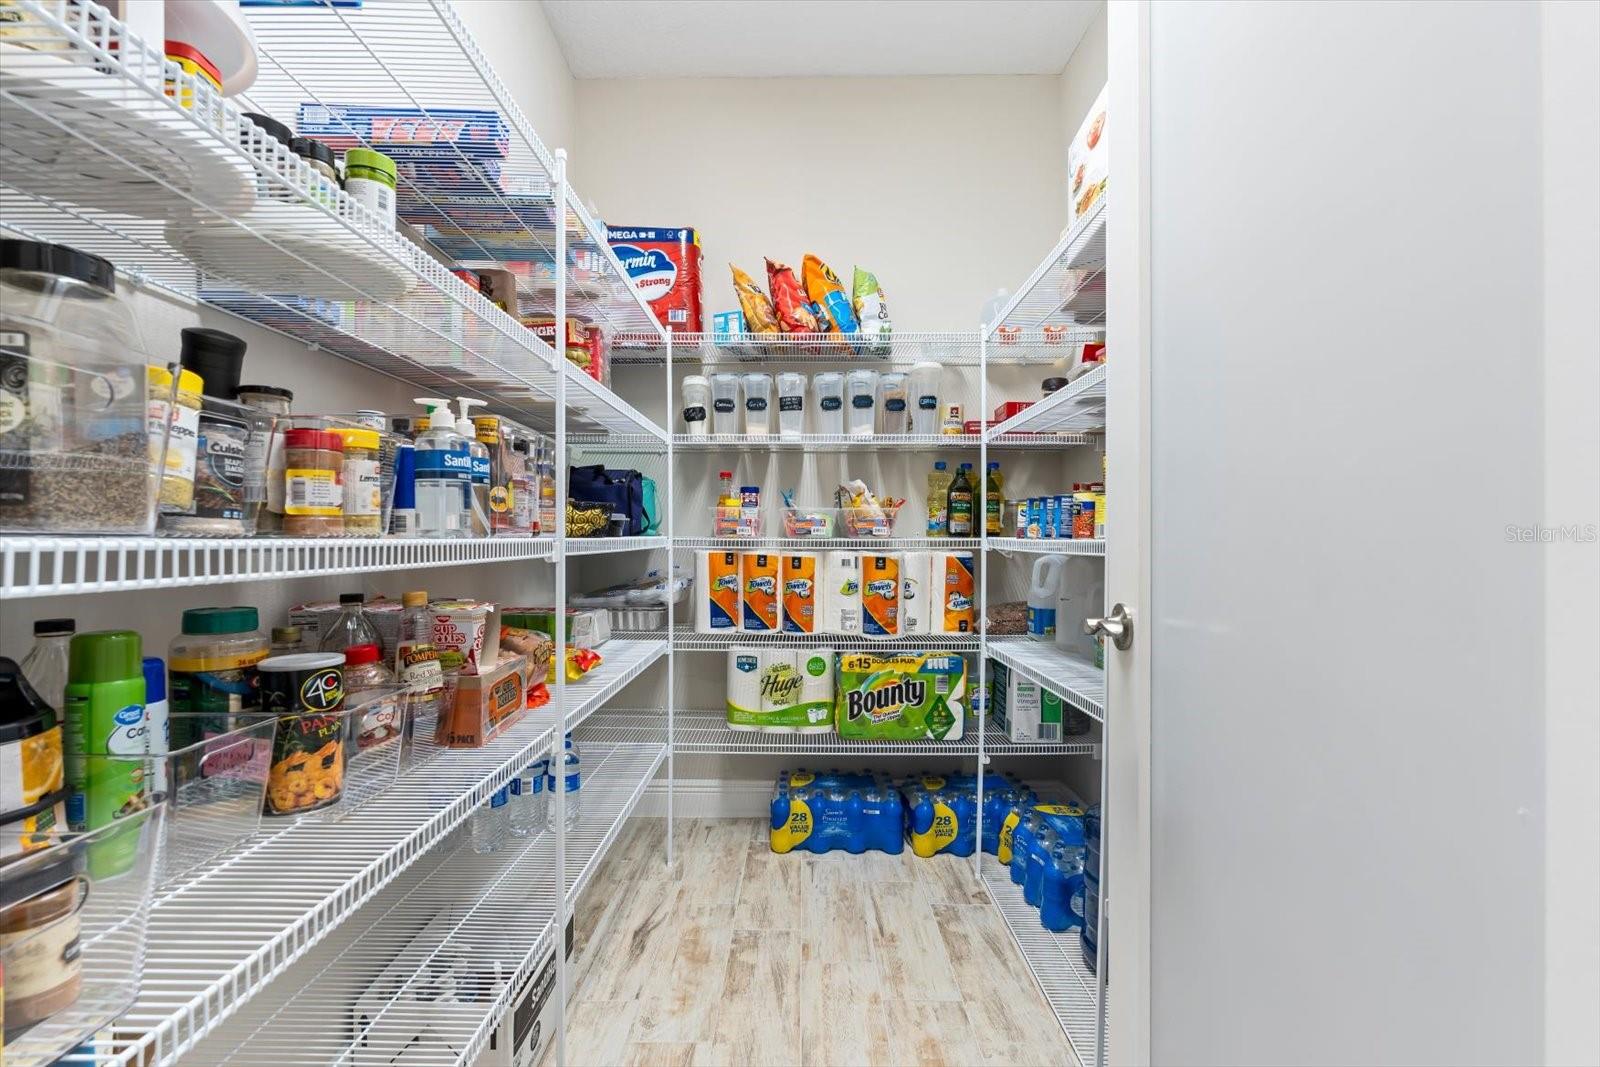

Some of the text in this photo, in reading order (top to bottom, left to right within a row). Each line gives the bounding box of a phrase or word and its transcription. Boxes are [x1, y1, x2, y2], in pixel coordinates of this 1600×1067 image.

[609, 231, 638, 239] MEGA
[639, 277, 671, 288] Strong
[749, 579, 772, 588] Towels
[786, 581, 808, 591] Towels
[868, 582, 892, 591] Towels
[760, 673, 803, 697] Huge
[847, 679, 926, 721] Bounty
[791, 812, 807, 822] 28
[936, 816, 952, 825] 28
